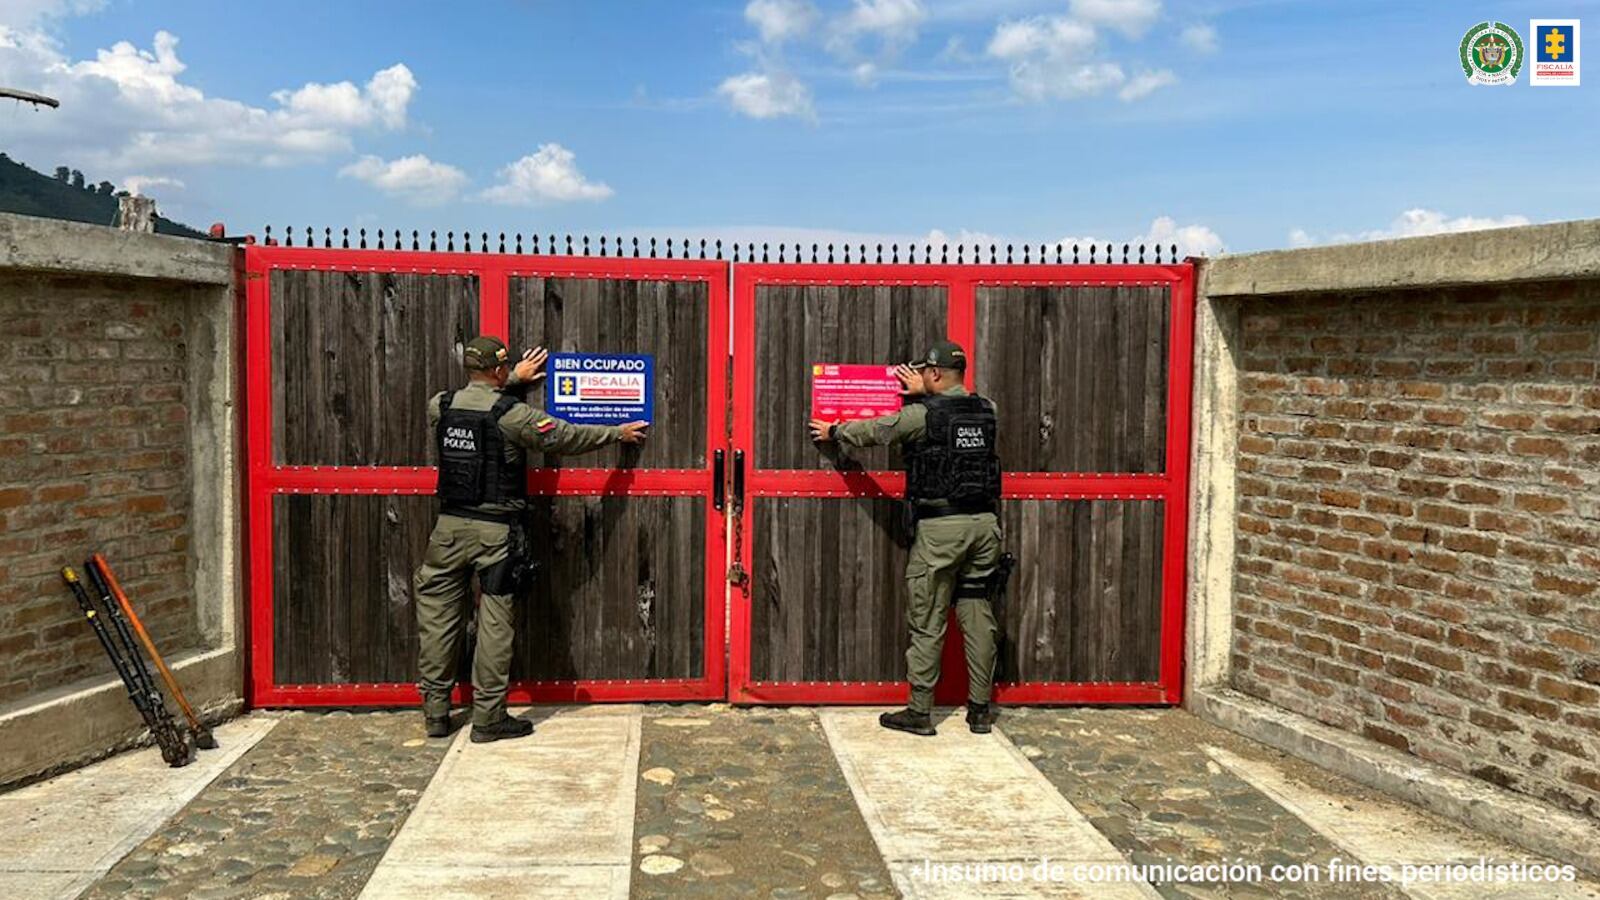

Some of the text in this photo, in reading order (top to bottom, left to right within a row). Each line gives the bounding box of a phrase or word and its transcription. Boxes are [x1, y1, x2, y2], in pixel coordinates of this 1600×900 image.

[554, 358, 646, 371] BIEN OCUPADO
[446, 427, 474, 440] GAULA
[957, 426, 984, 437] GAULA
